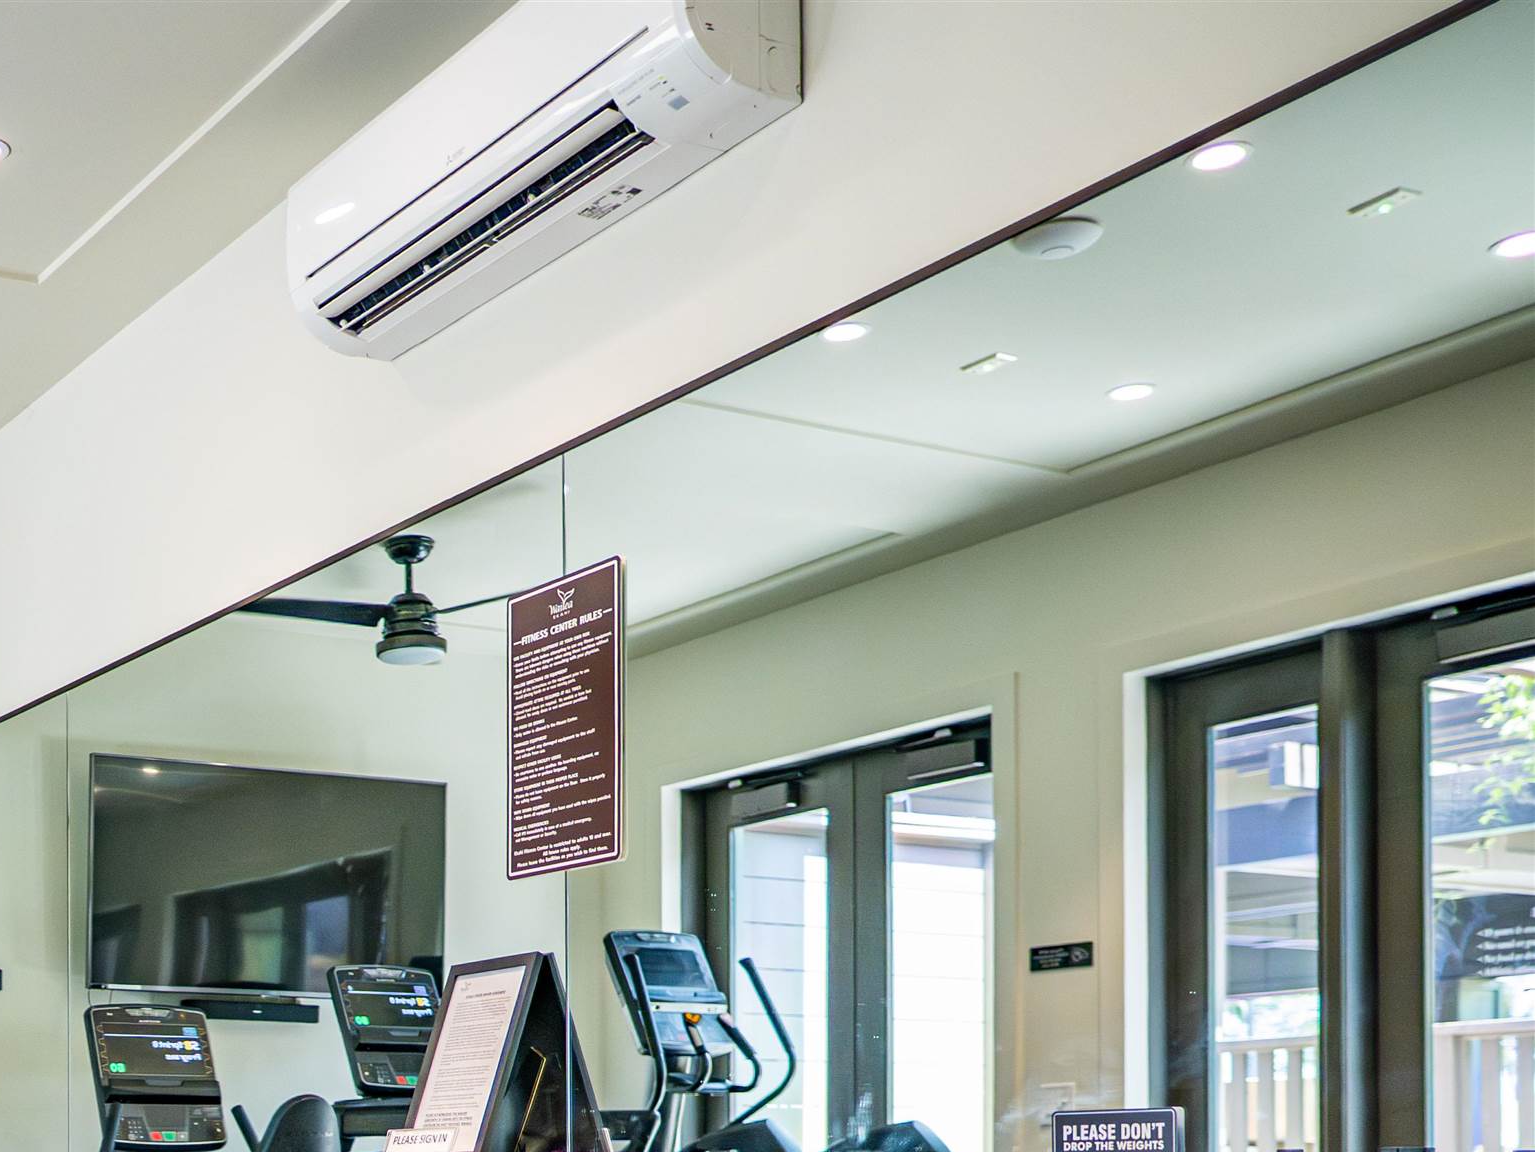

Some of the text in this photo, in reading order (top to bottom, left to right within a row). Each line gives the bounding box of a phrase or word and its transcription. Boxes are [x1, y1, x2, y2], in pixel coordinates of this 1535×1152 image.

[521, 609, 603, 646] FITNESS CENTER RULES
[393, 1133, 448, 1145] PLEASE SIGN IN
[1063, 1122, 1165, 1141] PLEASE DON'T
[1063, 1140, 1164, 1152] DROP THE WEIGHTS
